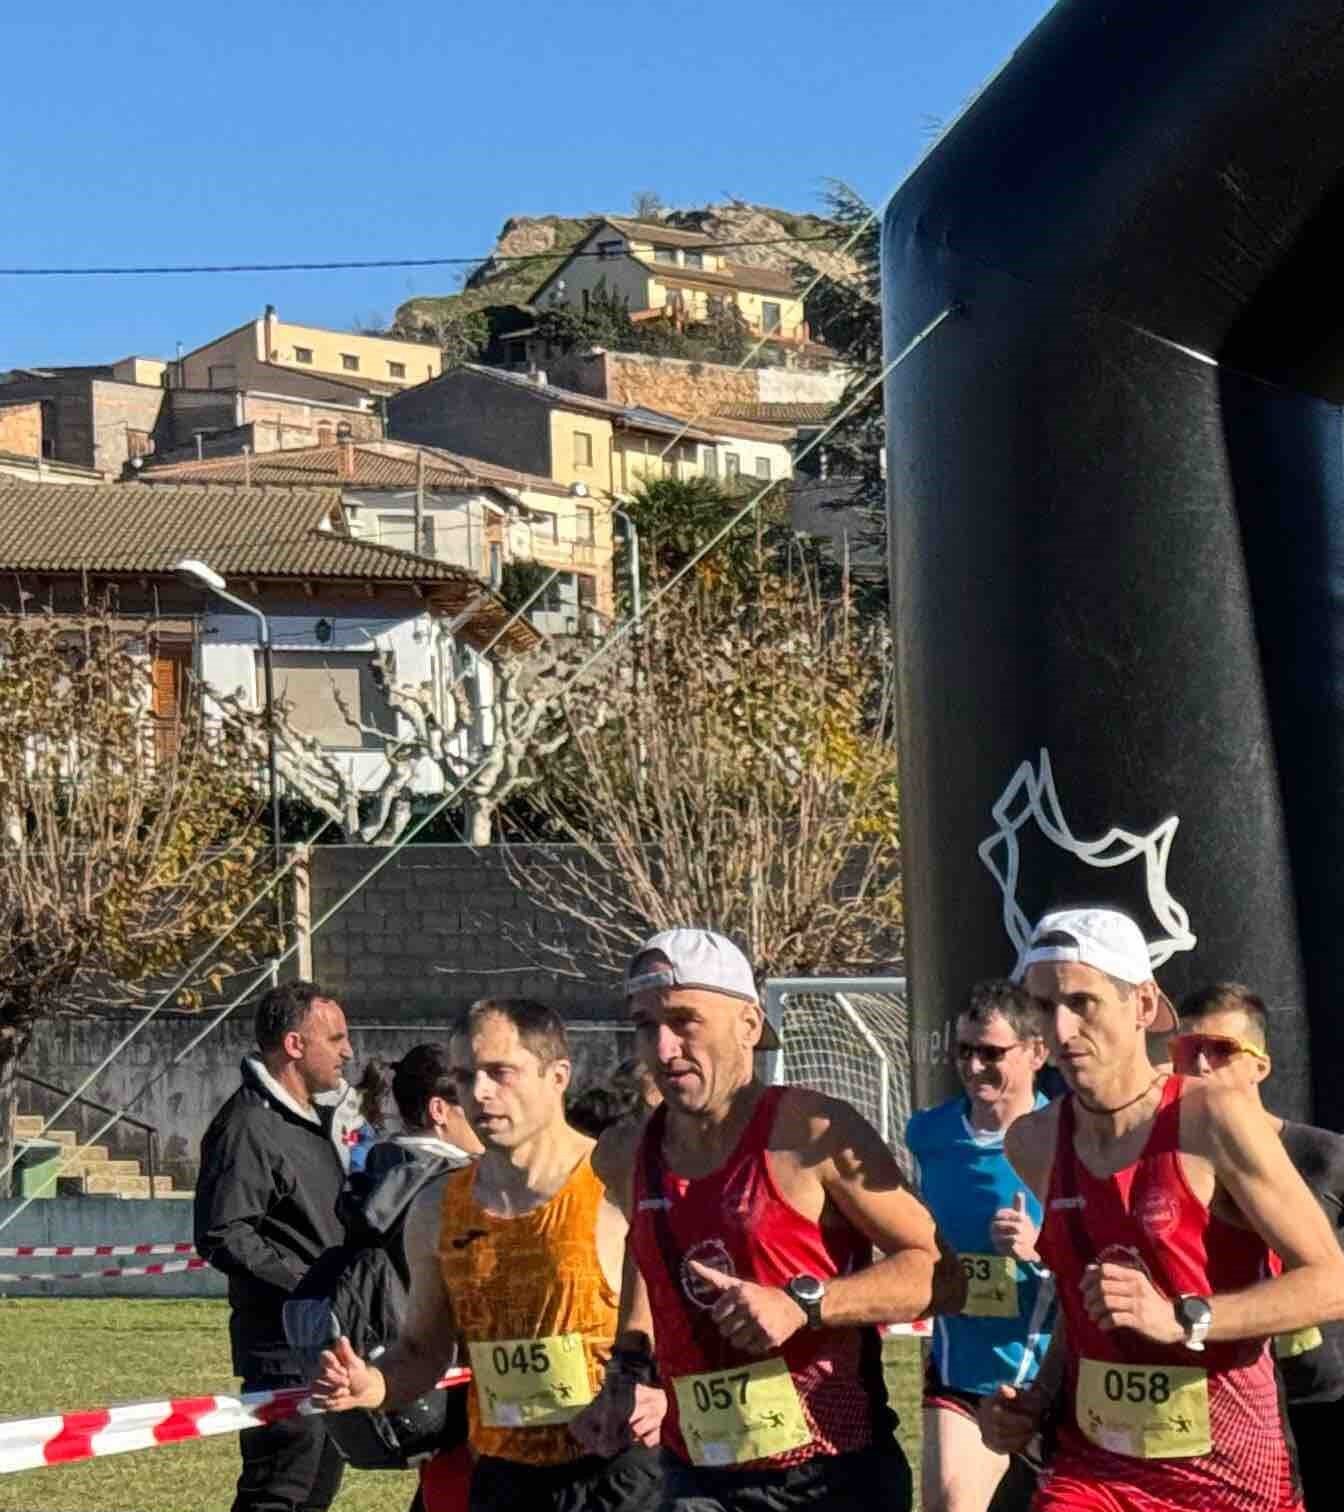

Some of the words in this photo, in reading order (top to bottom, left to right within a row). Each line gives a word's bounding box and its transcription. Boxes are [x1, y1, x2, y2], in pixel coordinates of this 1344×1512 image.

[959, 1257, 991, 1281] 63
[492, 1343, 550, 1376] 045
[692, 1373, 750, 1413] 057
[1104, 1369, 1171, 1404] 058
